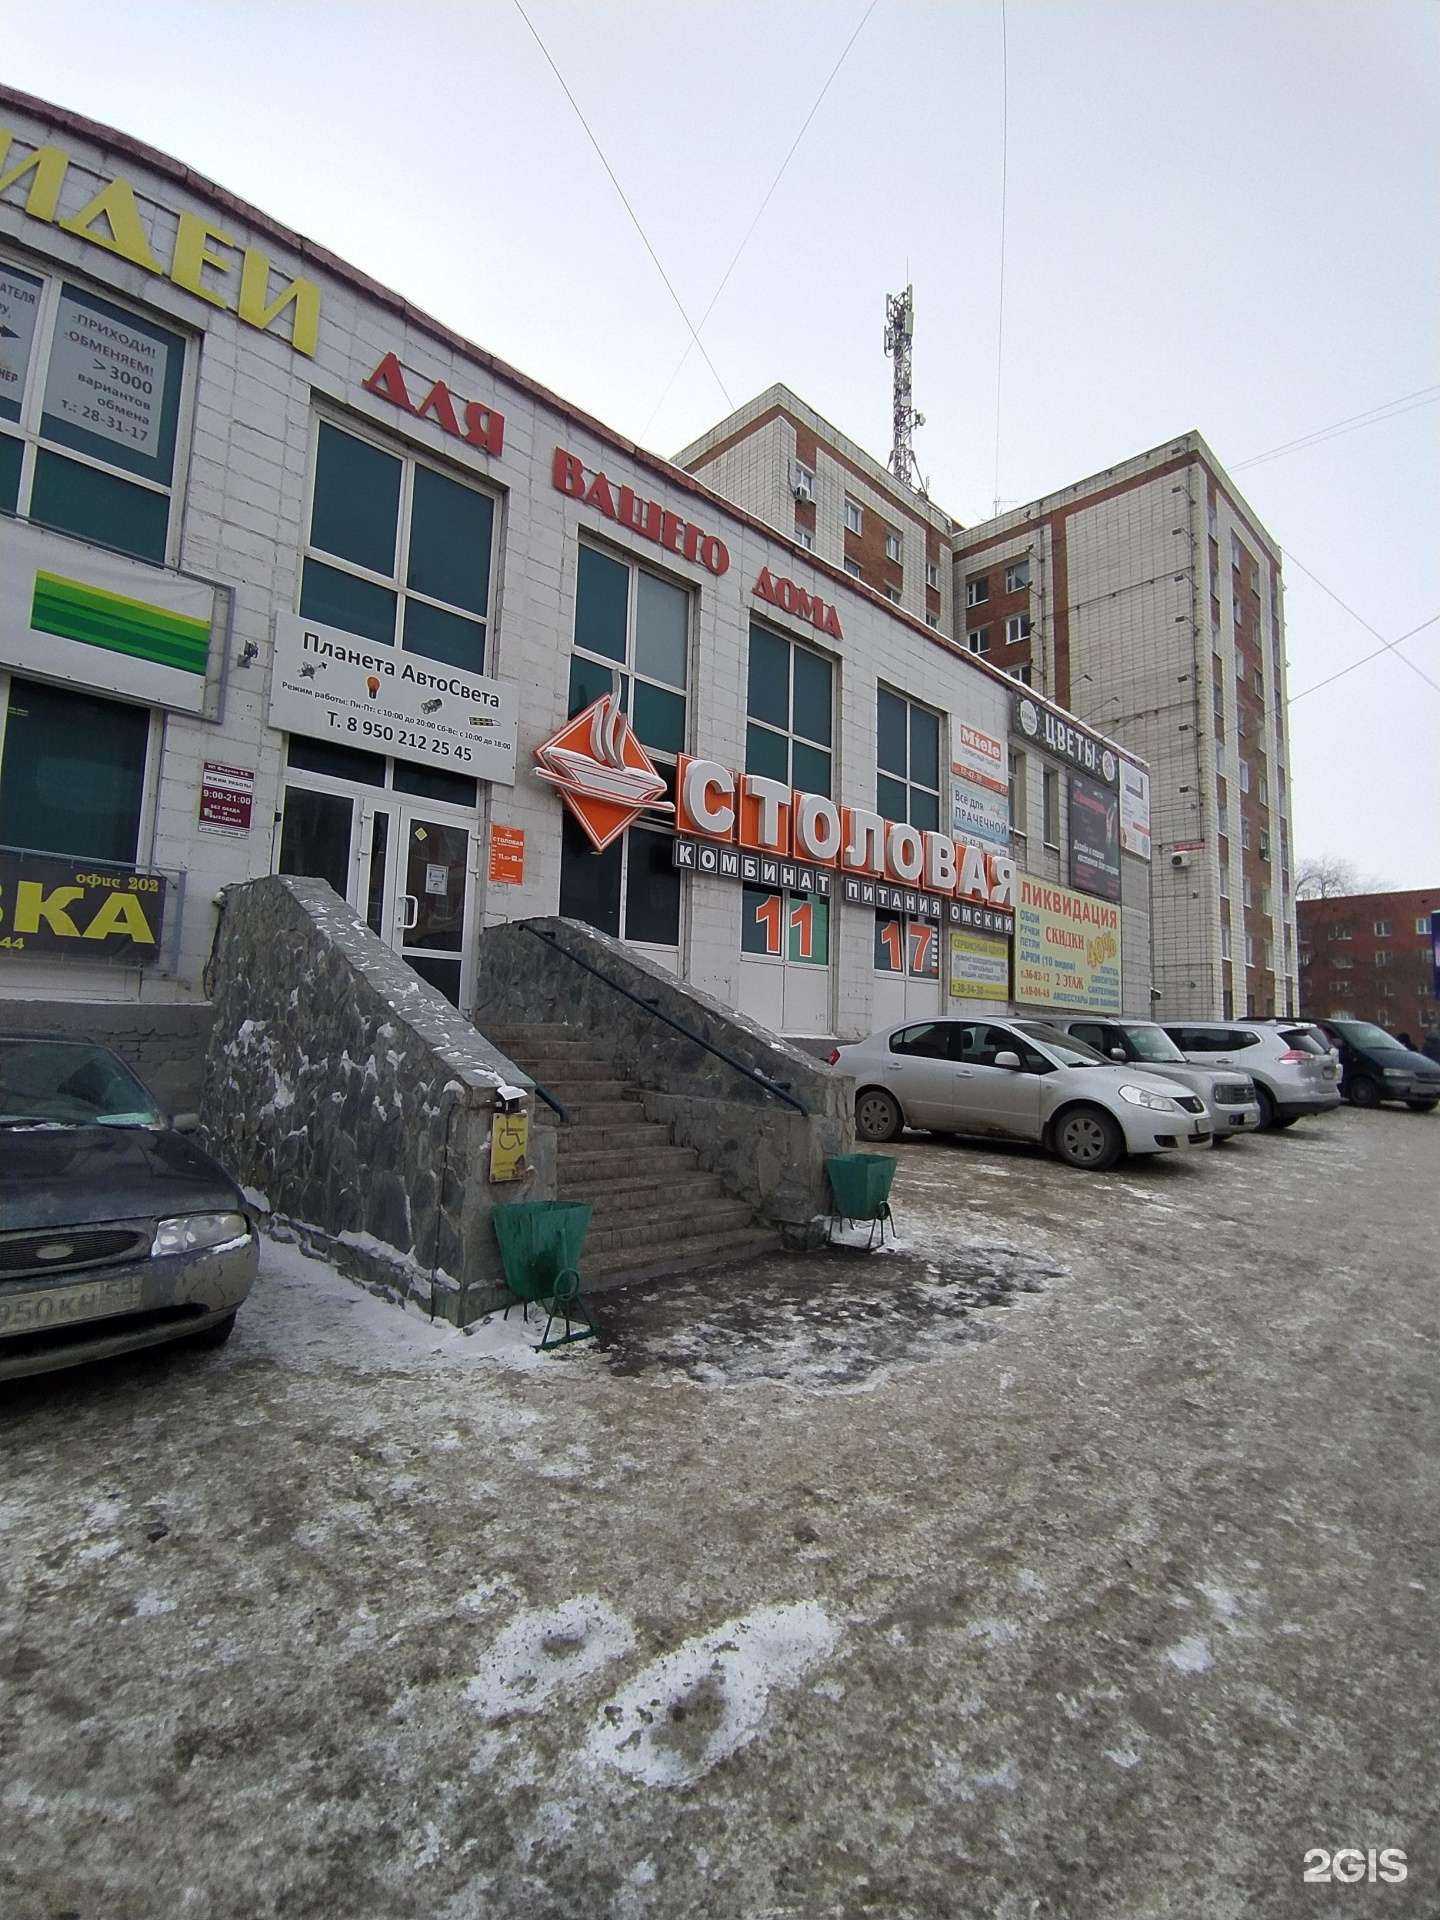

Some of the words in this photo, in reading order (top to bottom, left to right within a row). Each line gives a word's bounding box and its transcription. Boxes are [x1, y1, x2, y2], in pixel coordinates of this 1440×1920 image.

[78, 373, 151, 410] вариантов
[110, 366, 153, 394] 3000
[82, 405, 148, 441] 28-31-17
[97, 398, 150, 425] обмена
[361, 351, 505, 457] ДЛЯ
[552, 446, 730, 576] ВАШЕГО
[752, 565, 844, 641] ДОМА
[304, 631, 395, 676] Планета
[401, 664, 500, 708] АвтоСвета
[282, 681, 313, 697] Режим
[314, 690, 349, 706] работы:
[350, 700, 376, 713] Пн-Пт:
[383, 709, 404, 720] 10:00
[404, 716, 415, 725] до
[416, 718, 436, 730] 20:00
[465, 731, 483, 743] 10:00
[483, 738, 493, 746] до
[327, 711, 341, 729] Т.
[347, 717, 358, 732] 8
[363, 720, 394, 741] 950
[398, 730, 427, 750] 212
[431, 739, 450, 756] 25
[453, 744, 472, 762] 45
[961, 727, 1000, 758] Miele
[1046, 713, 1096, 770] ЦВЕТЫ
[203, 789, 251, 805] 9:00-21:00
[970, 798, 984, 809] для
[682, 759, 1017, 904] СТОЛОВАЯ
[955, 807, 1008, 836] ПРАЧЕЧНОЙ
[75, 873, 121, 888] офис
[128, 876, 159, 892] 202
[677, 843, 831, 895] КОМБИНАТ
[846, 879, 941, 916] ПИТАНИЯ
[0, 880, 155, 944] КА
[1021, 881, 1118, 930] ЛИКВИДАЦИЯ
[1046, 926, 1085, 951] СКИДКИ
